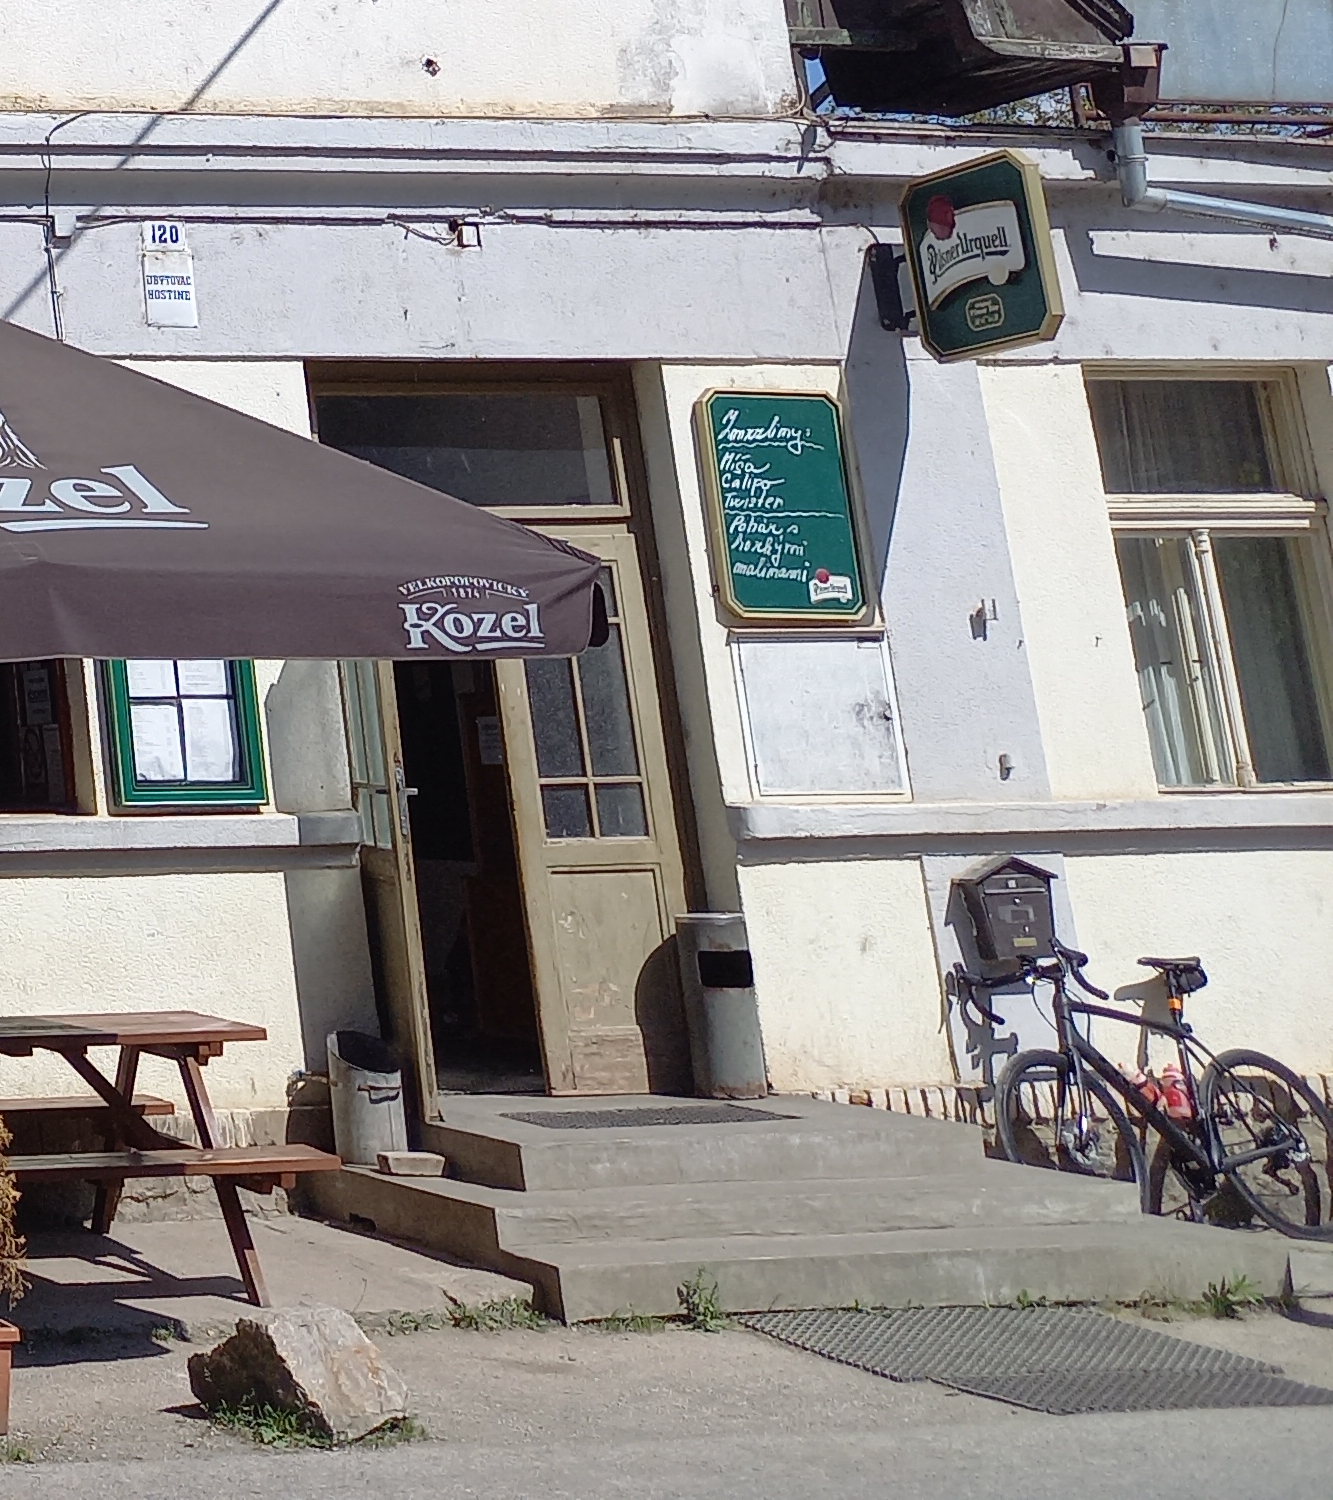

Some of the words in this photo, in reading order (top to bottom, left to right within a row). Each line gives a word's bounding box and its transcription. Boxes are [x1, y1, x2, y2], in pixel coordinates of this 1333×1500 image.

[151, 223, 179, 244] 120
[926, 243, 960, 285] Pilsner
[956, 226, 1008, 261] Urquell
[721, 473, 785, 496] Calipo
[724, 493, 784, 510] Twister
[398, 602, 546, 653] Kozel
